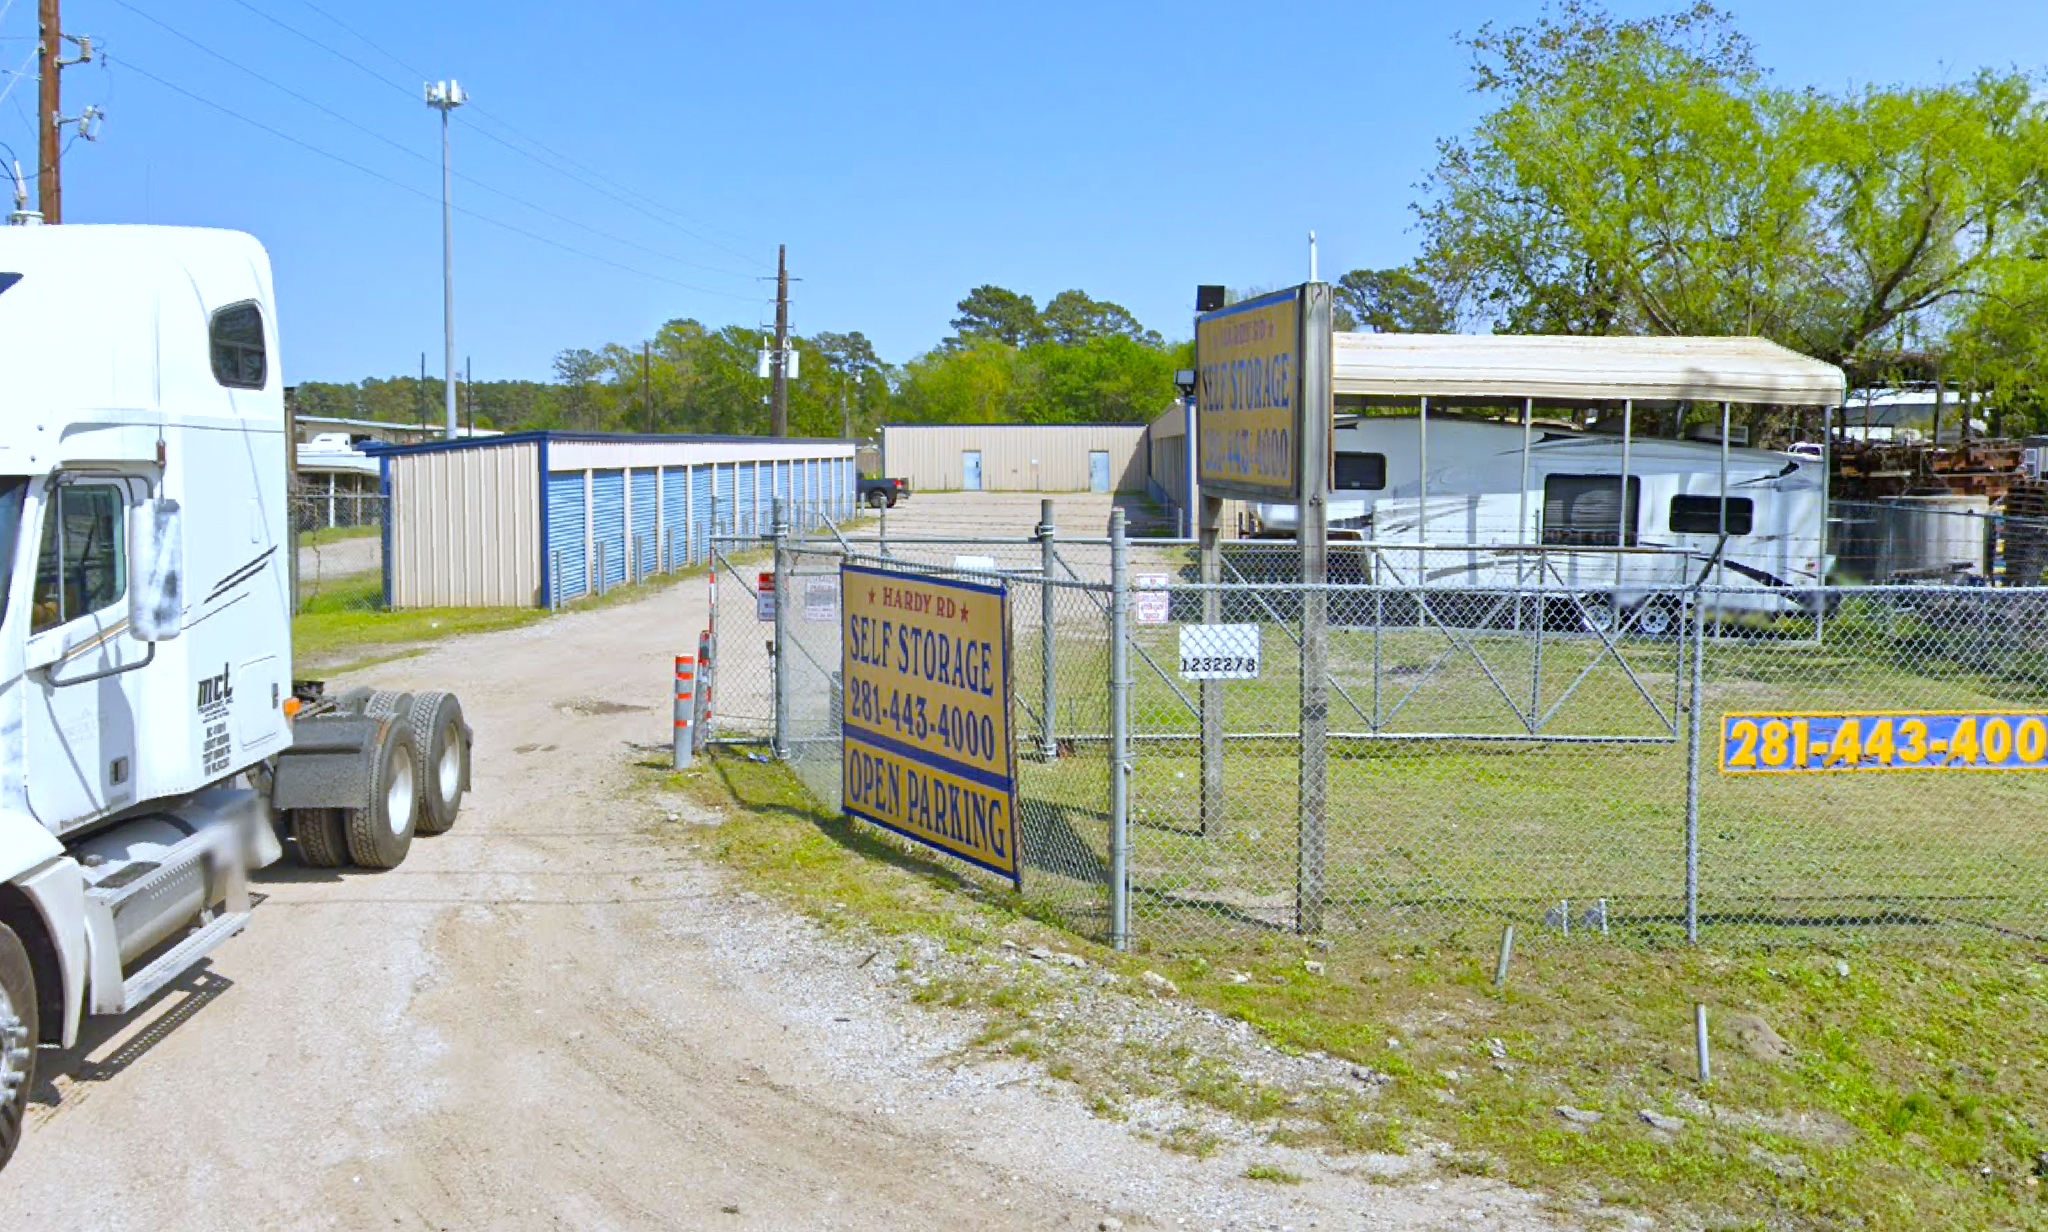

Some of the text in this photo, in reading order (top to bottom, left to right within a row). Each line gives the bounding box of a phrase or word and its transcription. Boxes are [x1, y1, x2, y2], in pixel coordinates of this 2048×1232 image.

[1202, 352, 1289, 411] SELF STORAGE
[882, 585, 956, 619] HARDY RD
[850, 613, 995, 698] SELF STORAGE
[1181, 657, 1256, 673] 1232278
[850, 675, 996, 762] 281-443-4000
[1729, 718, 2048, 767] 281-443-400
[849, 748, 1007, 860] OPEN PARKING
